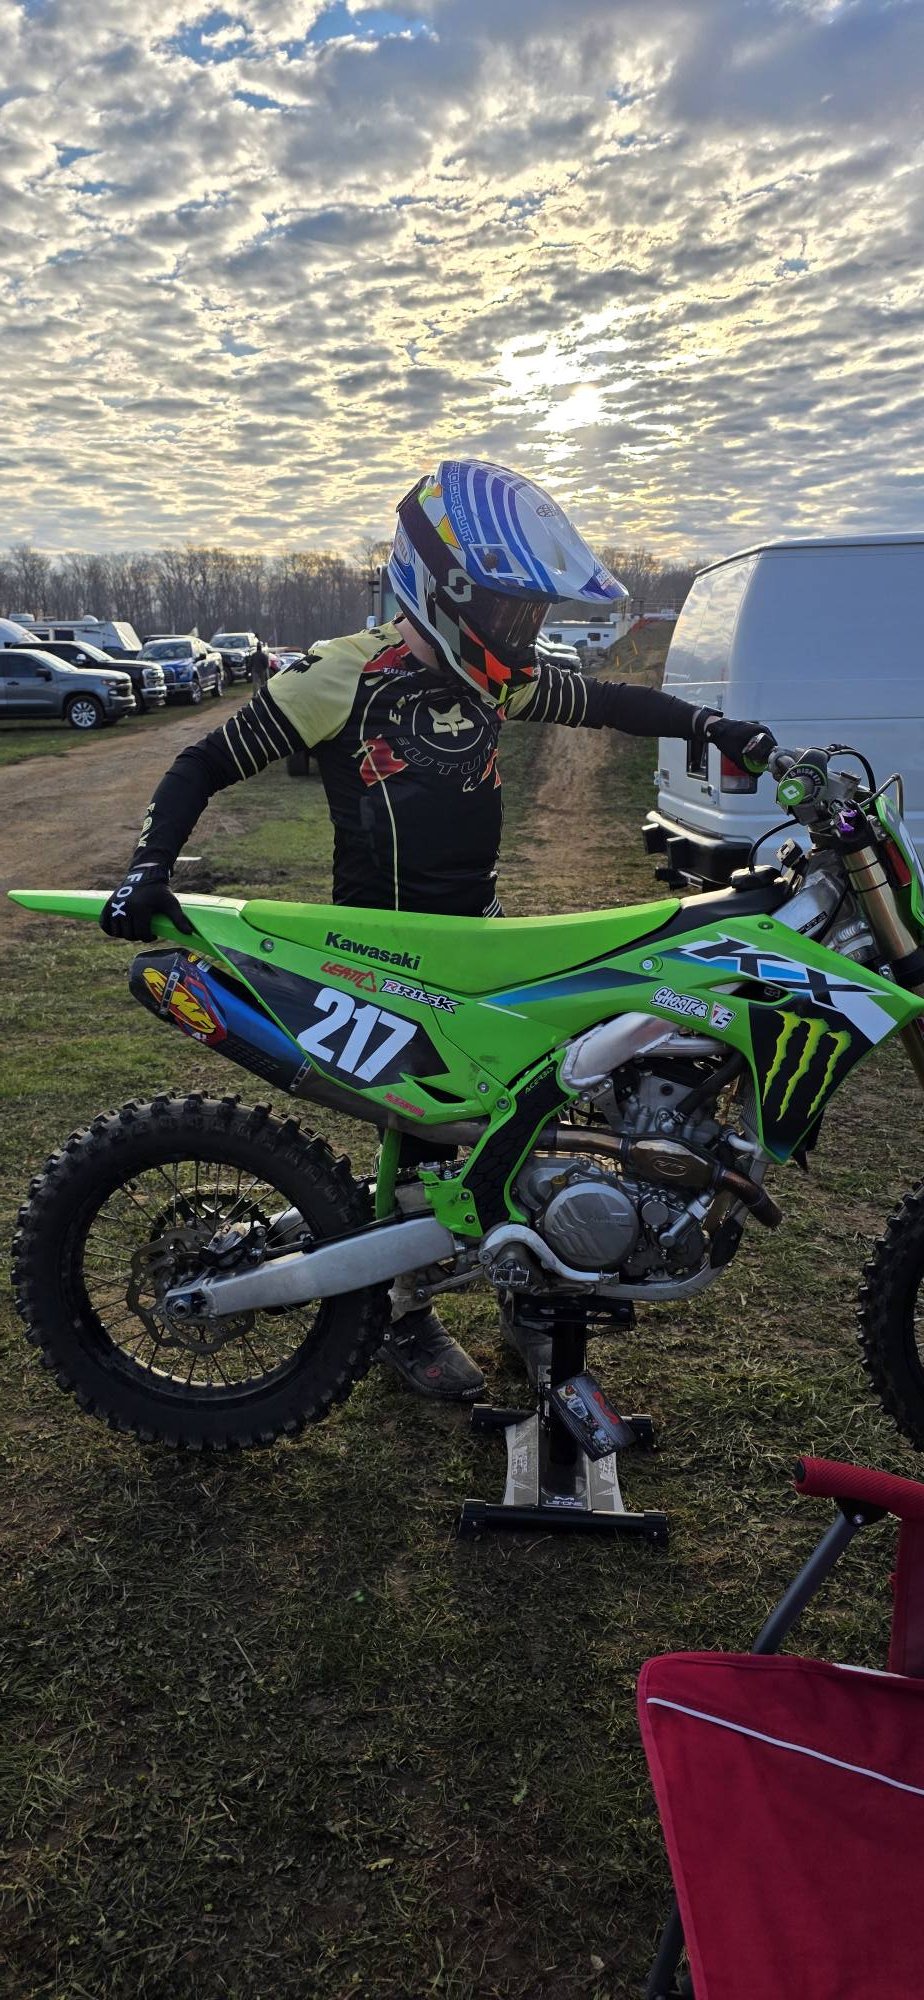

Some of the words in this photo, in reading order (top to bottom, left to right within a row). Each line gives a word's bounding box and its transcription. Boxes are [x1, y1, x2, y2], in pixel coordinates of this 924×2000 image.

[111, 872, 144, 917] FOX
[325, 931, 421, 971] Kawasaki
[297, 987, 418, 1083] 217
